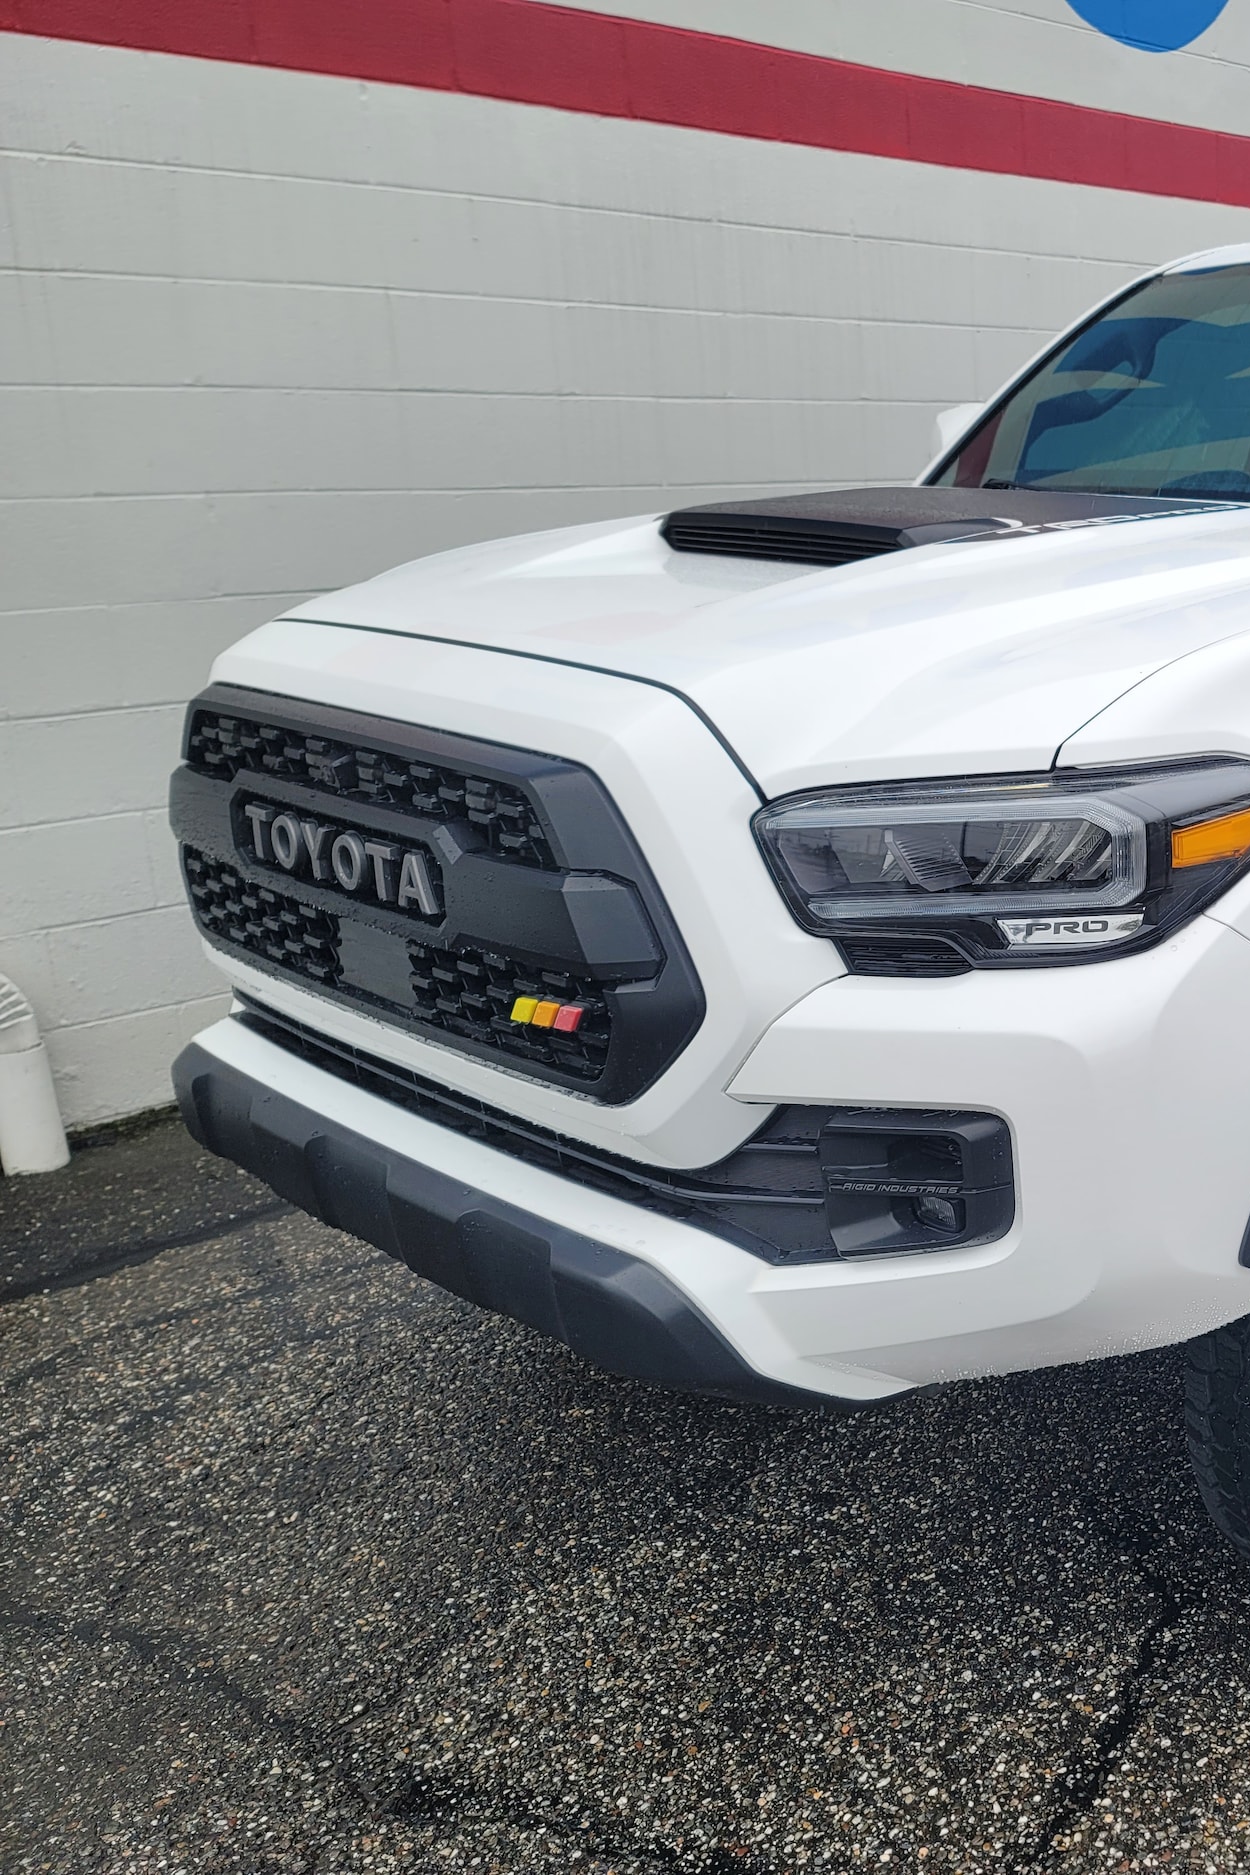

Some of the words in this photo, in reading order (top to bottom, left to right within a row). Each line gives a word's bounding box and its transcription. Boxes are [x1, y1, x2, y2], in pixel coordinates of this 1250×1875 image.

[244, 801, 441, 915] TOYOTA
[1025, 920, 1109, 936] PRO
[842, 1182, 876, 1191] RIGID
[877, 1184, 960, 1195] INDUSTRIES
